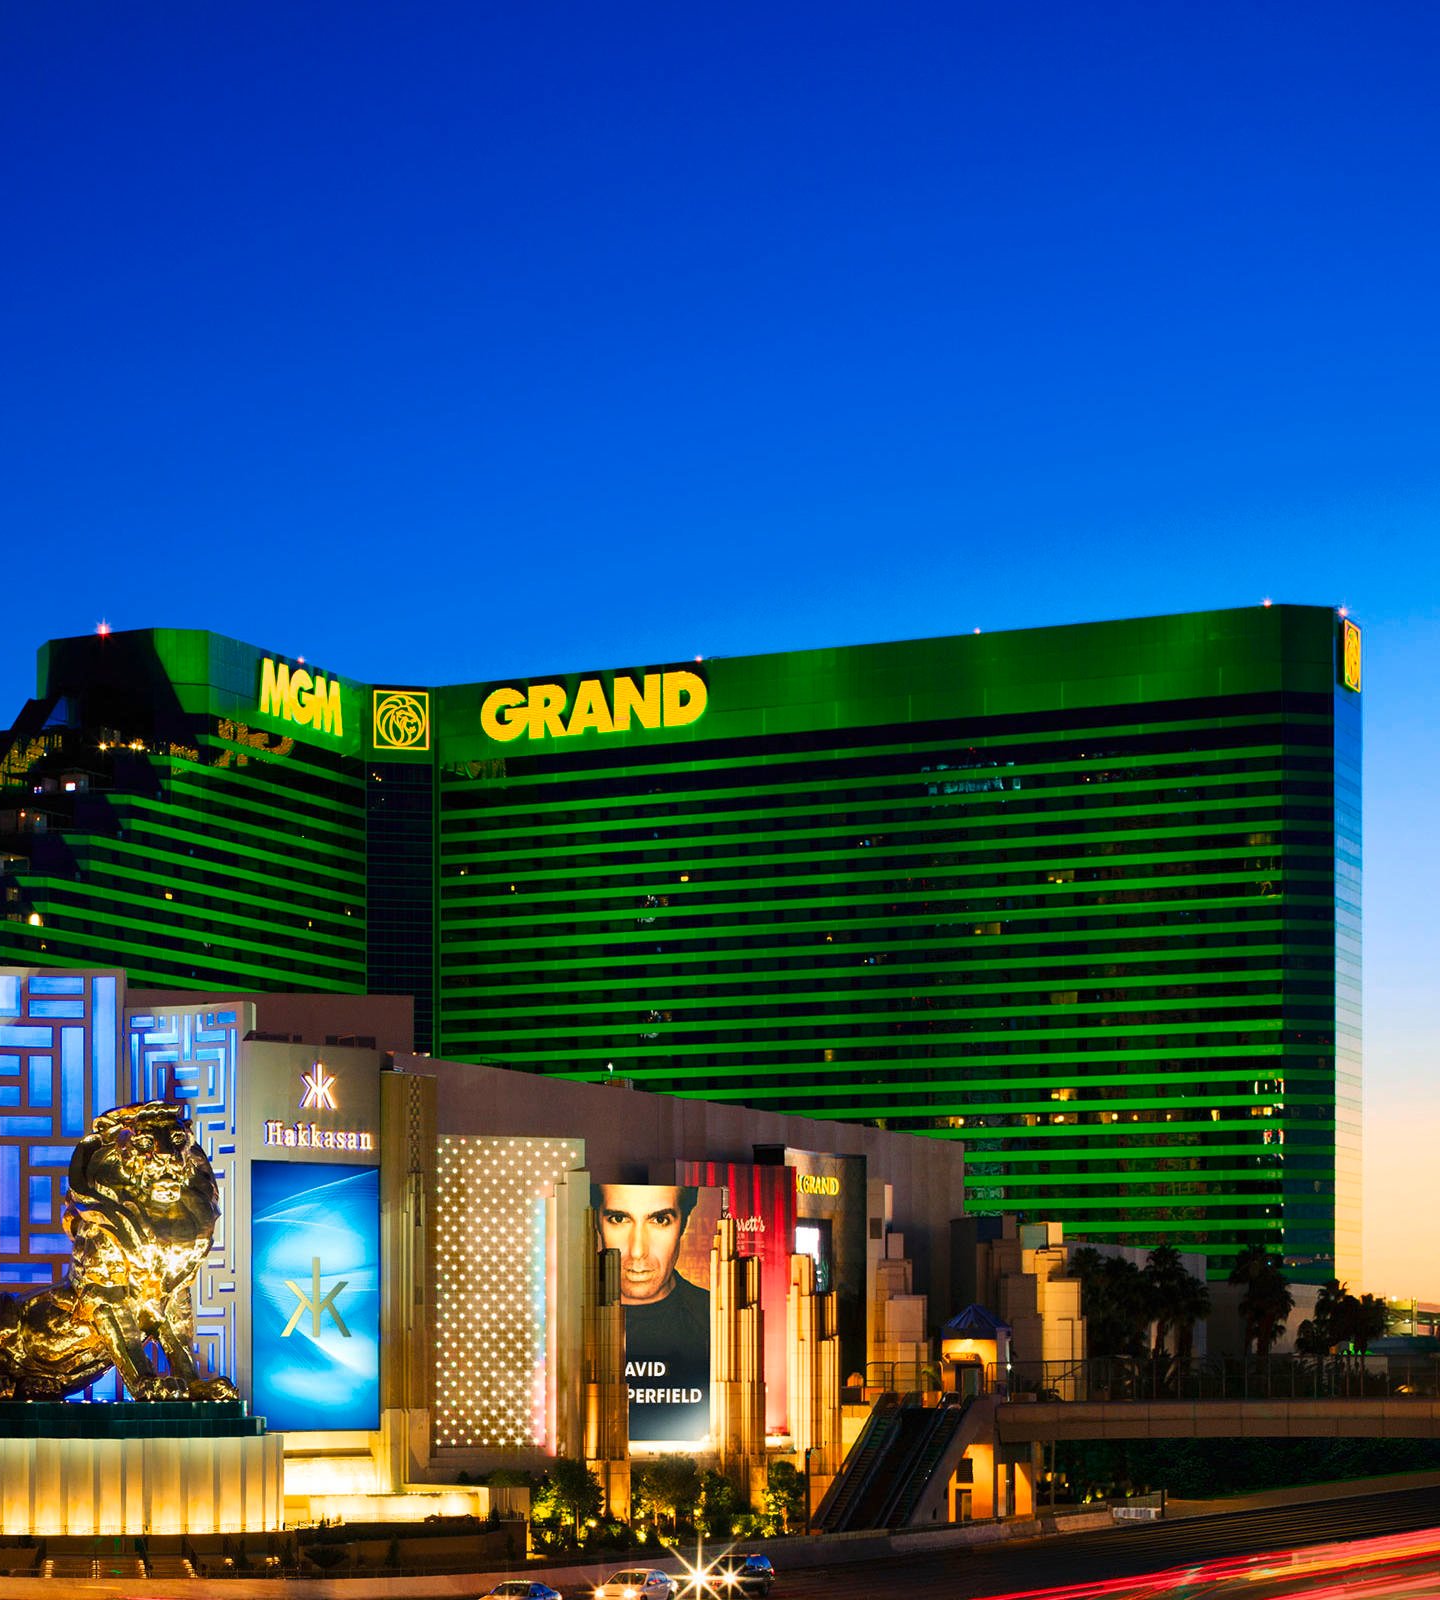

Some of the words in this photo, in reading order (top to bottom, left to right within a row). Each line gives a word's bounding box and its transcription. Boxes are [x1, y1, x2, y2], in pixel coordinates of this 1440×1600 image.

[260, 657, 343, 737] MGM
[480, 671, 708, 742] GRAND
[263, 1120, 374, 1150] Hakkasan
[803, 1175, 840, 1195] GRAND
[736, 1215, 766, 1233] rrett's
[624, 1361, 666, 1377] AVID
[628, 1388, 703, 1404] PERFIELD
